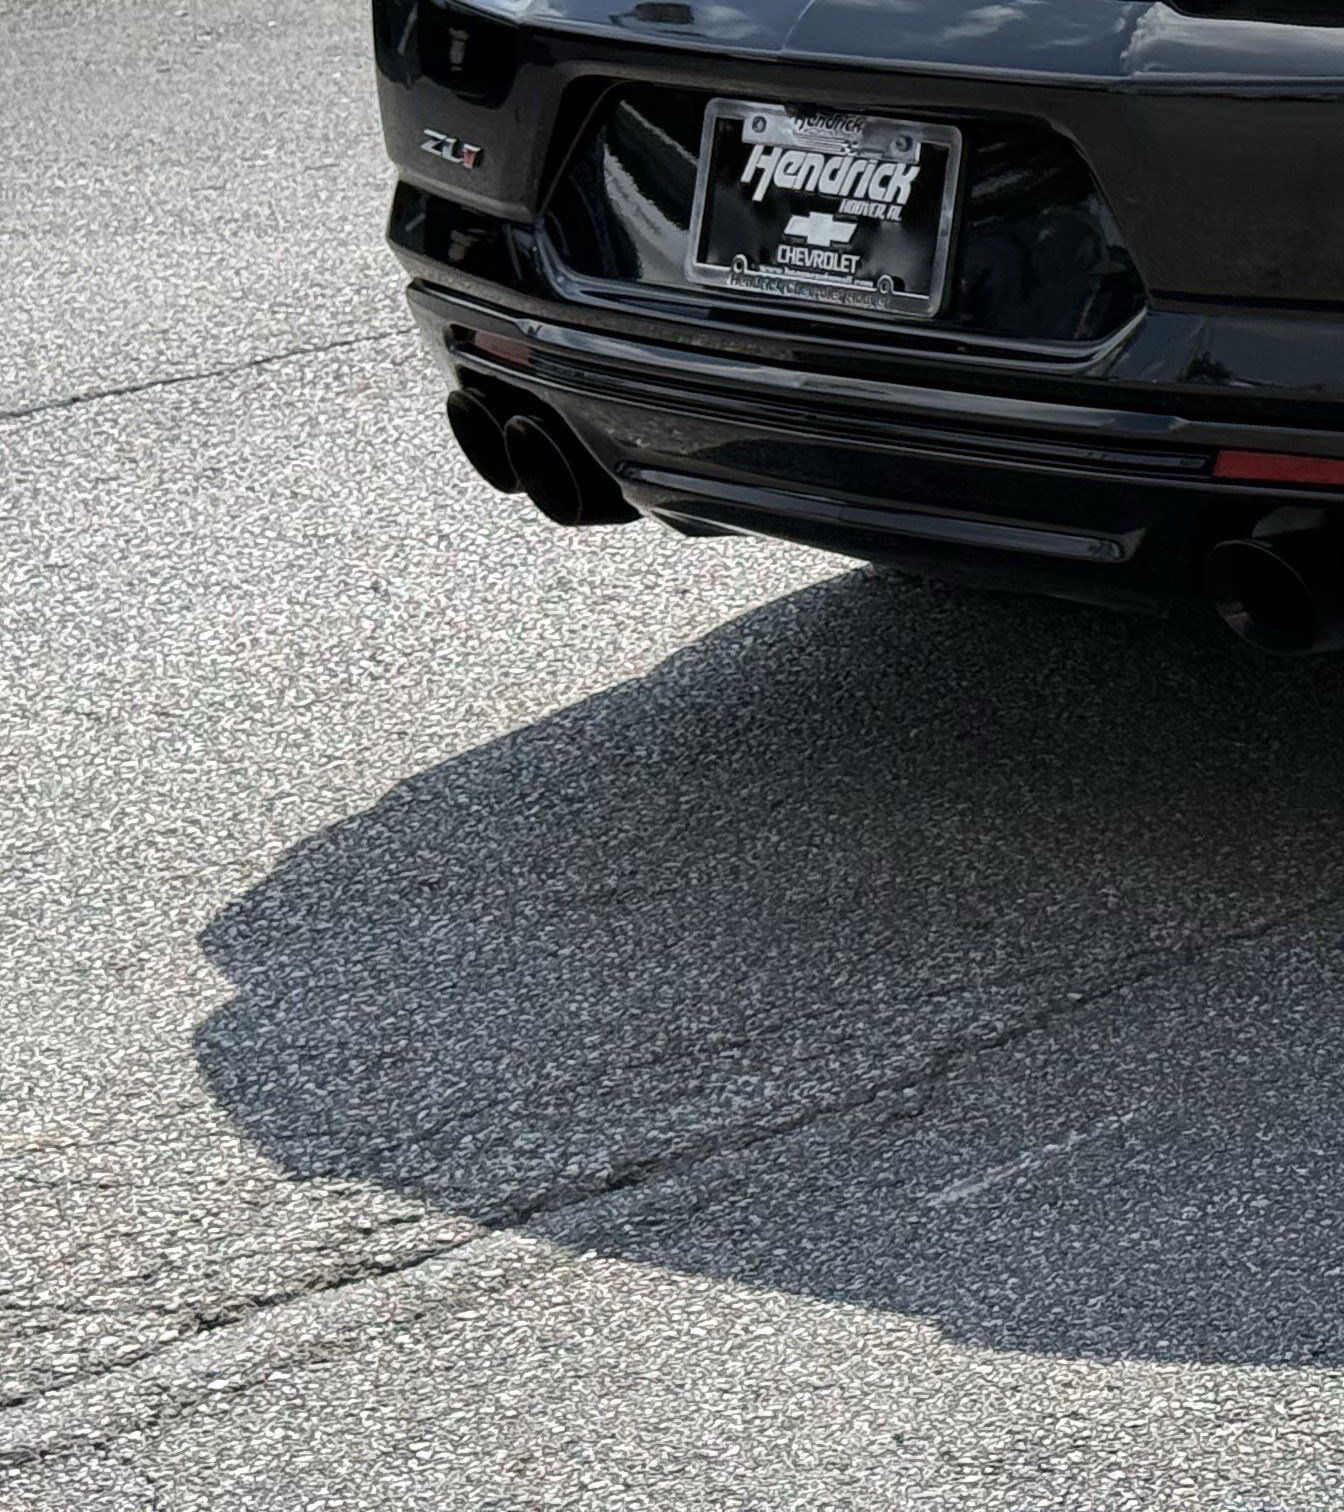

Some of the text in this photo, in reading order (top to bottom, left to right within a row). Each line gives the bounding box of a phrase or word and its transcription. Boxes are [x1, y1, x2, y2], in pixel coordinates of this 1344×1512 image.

[421, 129, 481, 168] ZL1
[741, 144, 921, 204] Hendrick
[776, 244, 861, 273] CHEVROLET
